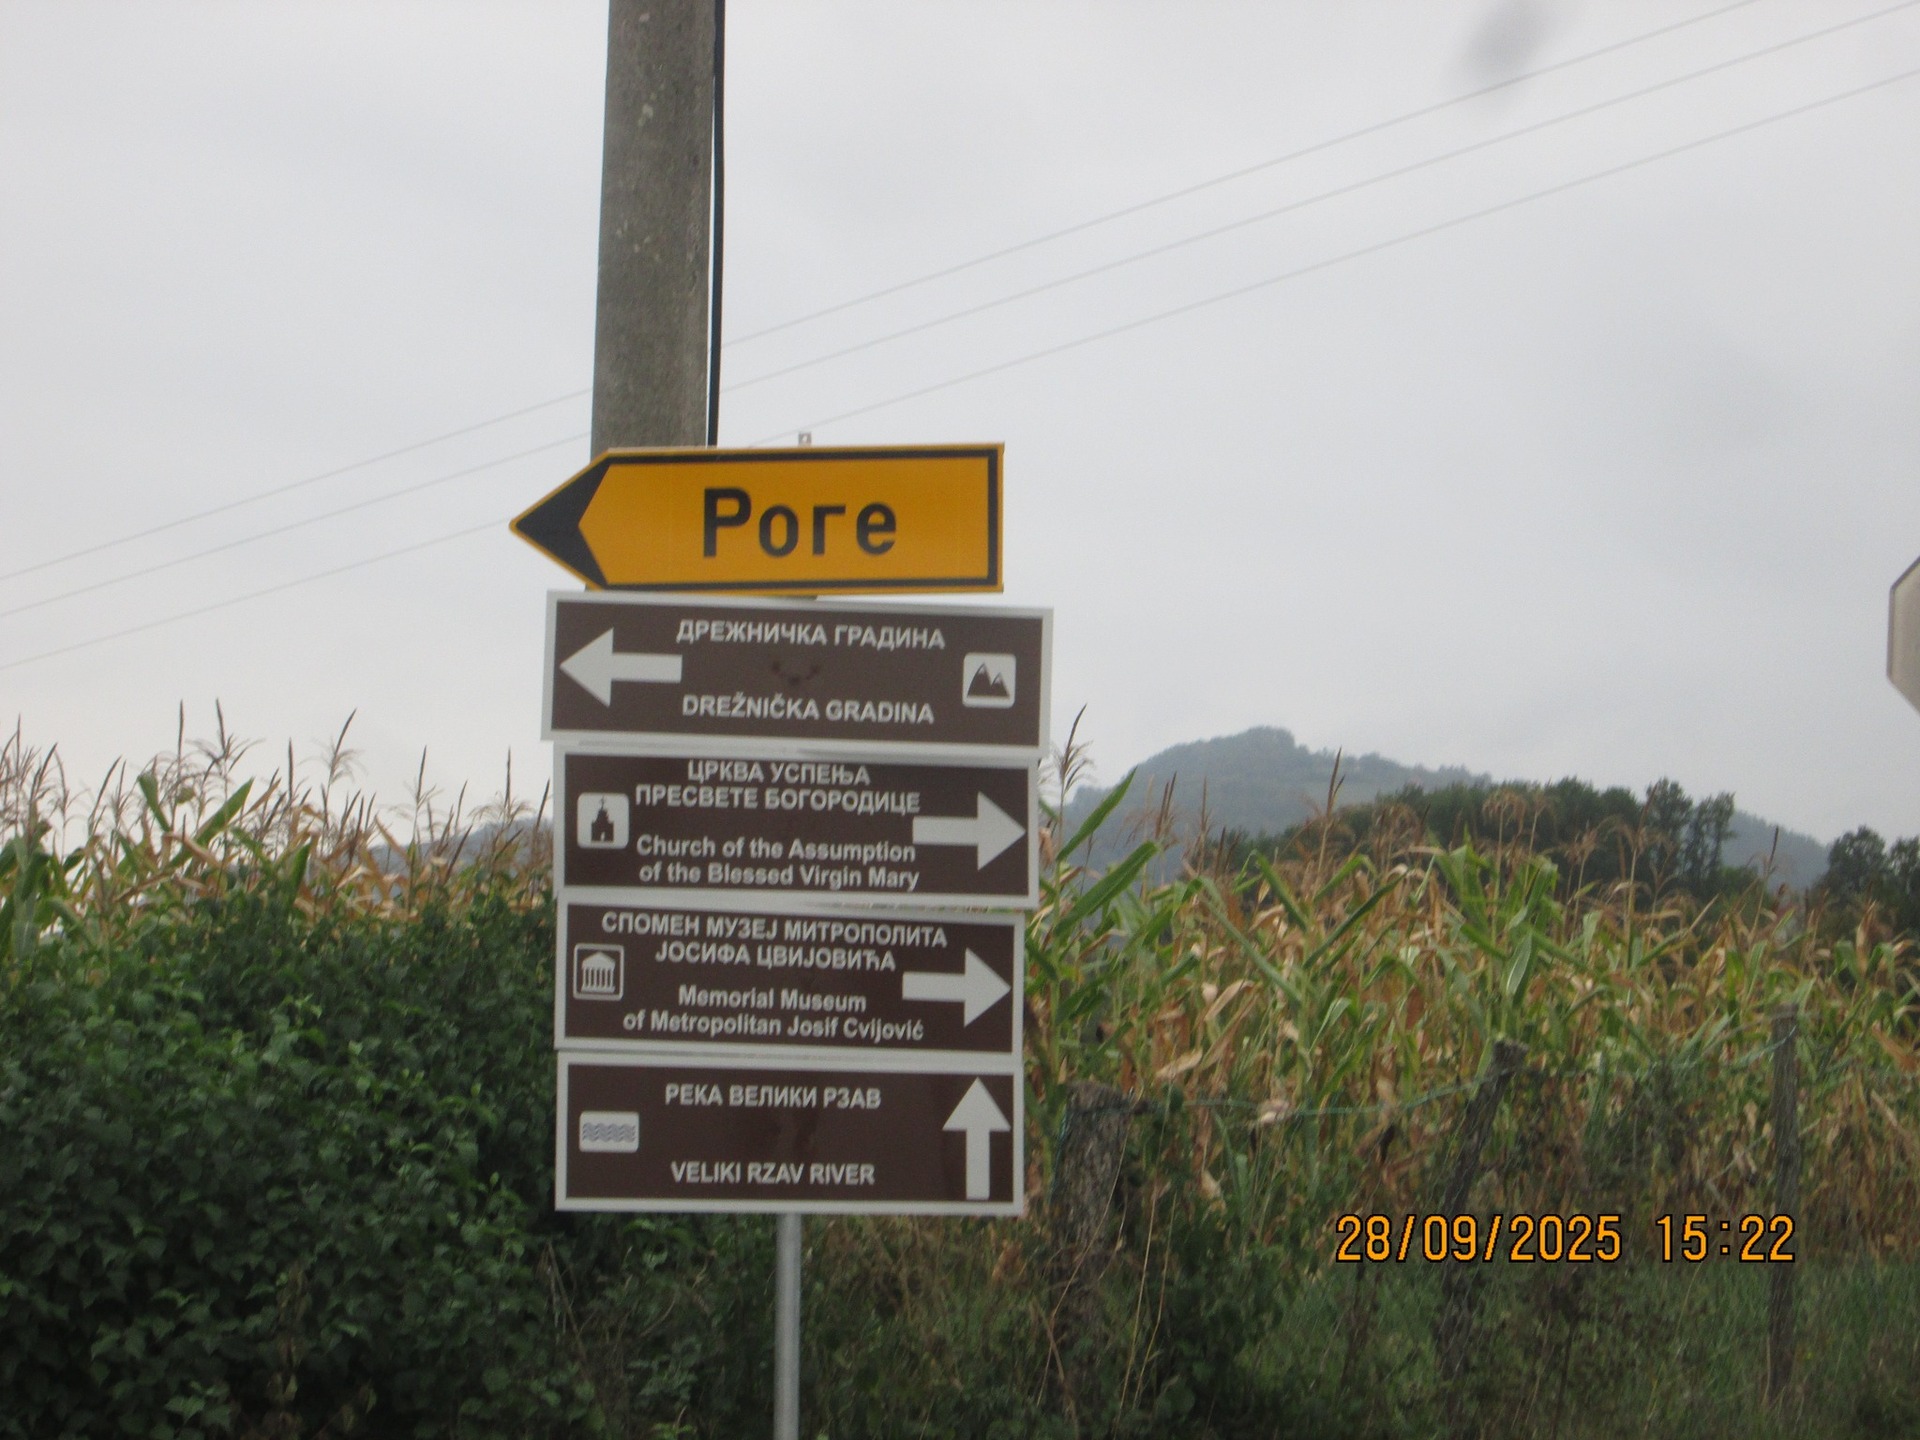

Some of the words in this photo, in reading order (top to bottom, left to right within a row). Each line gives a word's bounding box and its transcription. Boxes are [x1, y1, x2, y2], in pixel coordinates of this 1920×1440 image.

[703, 487, 896, 559] Роге
[675, 619, 828, 645] ДРЕЖНИЧКА
[834, 625, 946, 650] ГРАДИНА
[682, 690, 820, 720] DREŽNIČKA
[825, 699, 934, 724] GRADINA
[688, 760, 764, 784] ЦРКВА
[770, 762, 870, 785] УСПЕЊА
[635, 784, 758, 808] ПРЕСВЕТЕ
[765, 788, 920, 816] БОГОРОДИЦЕ
[636, 835, 716, 856] Church
[722, 837, 745, 857] of
[749, 838, 783, 858] the
[788, 838, 916, 865] Assumption
[639, 862, 661, 881] of
[667, 862, 701, 882] the
[708, 862, 793, 885] Blessed
[799, 865, 862, 890] Virgin
[868, 867, 920, 891] Mary
[602, 912, 700, 936] СПОМЕН
[706, 917, 778, 940] МУЗЕЈ
[784, 920, 947, 947] МИТРОПОЛИТА
[655, 941, 751, 964] ЈОСИФА
[757, 945, 896, 970] ЦВИЈОВИЋА
[679, 985, 774, 1008] Memorial
[780, 989, 866, 1012] Museum
[623, 1010, 645, 1030] of
[651, 1010, 781, 1037] Metropolitan
[787, 1016, 839, 1036] Josif
[843, 1017, 923, 1043] Cvijović
[665, 1084, 723, 1105] РЕКА
[729, 1085, 817, 1107] ВЕЛИКИ
[823, 1088, 881, 1108] РЗАВ
[671, 1162, 741, 1182] VELIKI
[747, 1163, 804, 1183] RZAV
[810, 1164, 875, 1184] RIVER
